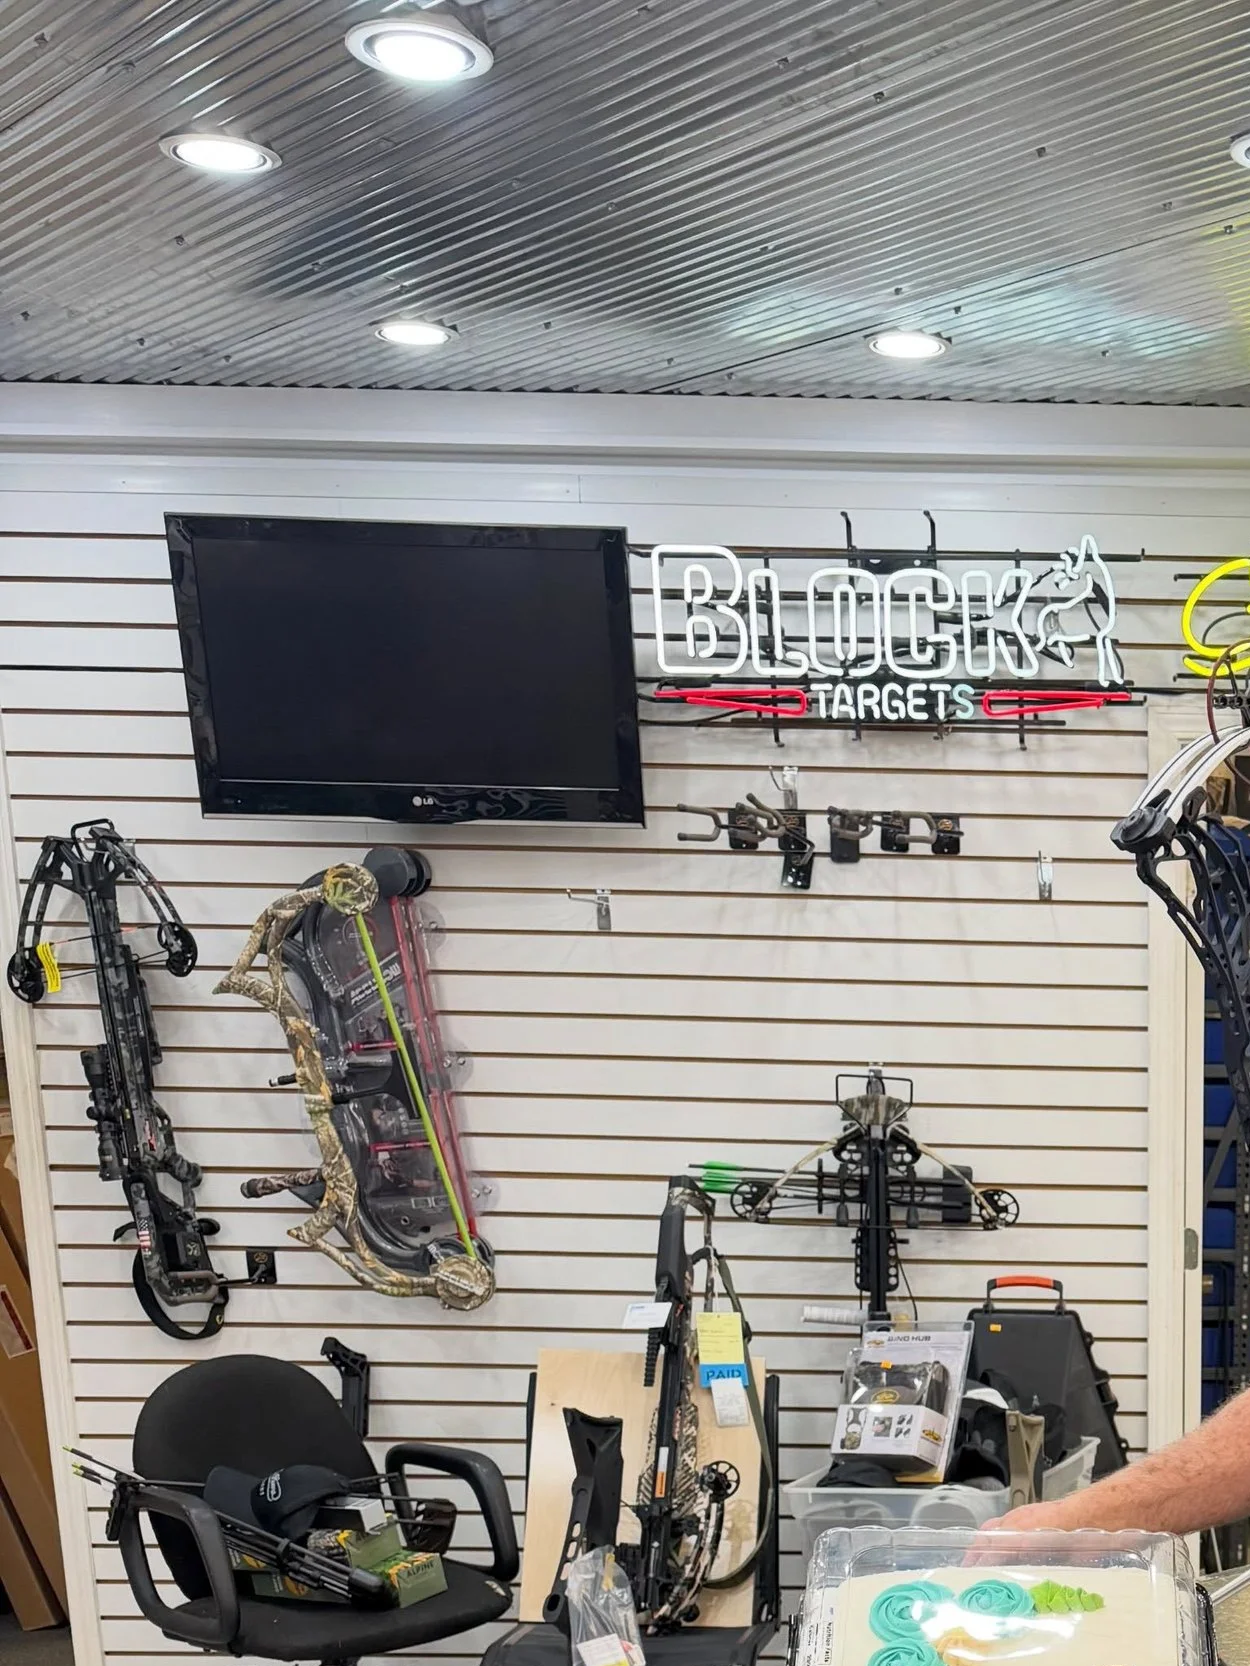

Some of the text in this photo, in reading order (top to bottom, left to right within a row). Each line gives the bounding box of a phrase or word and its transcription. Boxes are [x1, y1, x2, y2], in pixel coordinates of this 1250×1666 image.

[651, 544, 1040, 678] BLOCK
[810, 682, 975, 720] TARGETS
[707, 1368, 741, 1381] PAID
